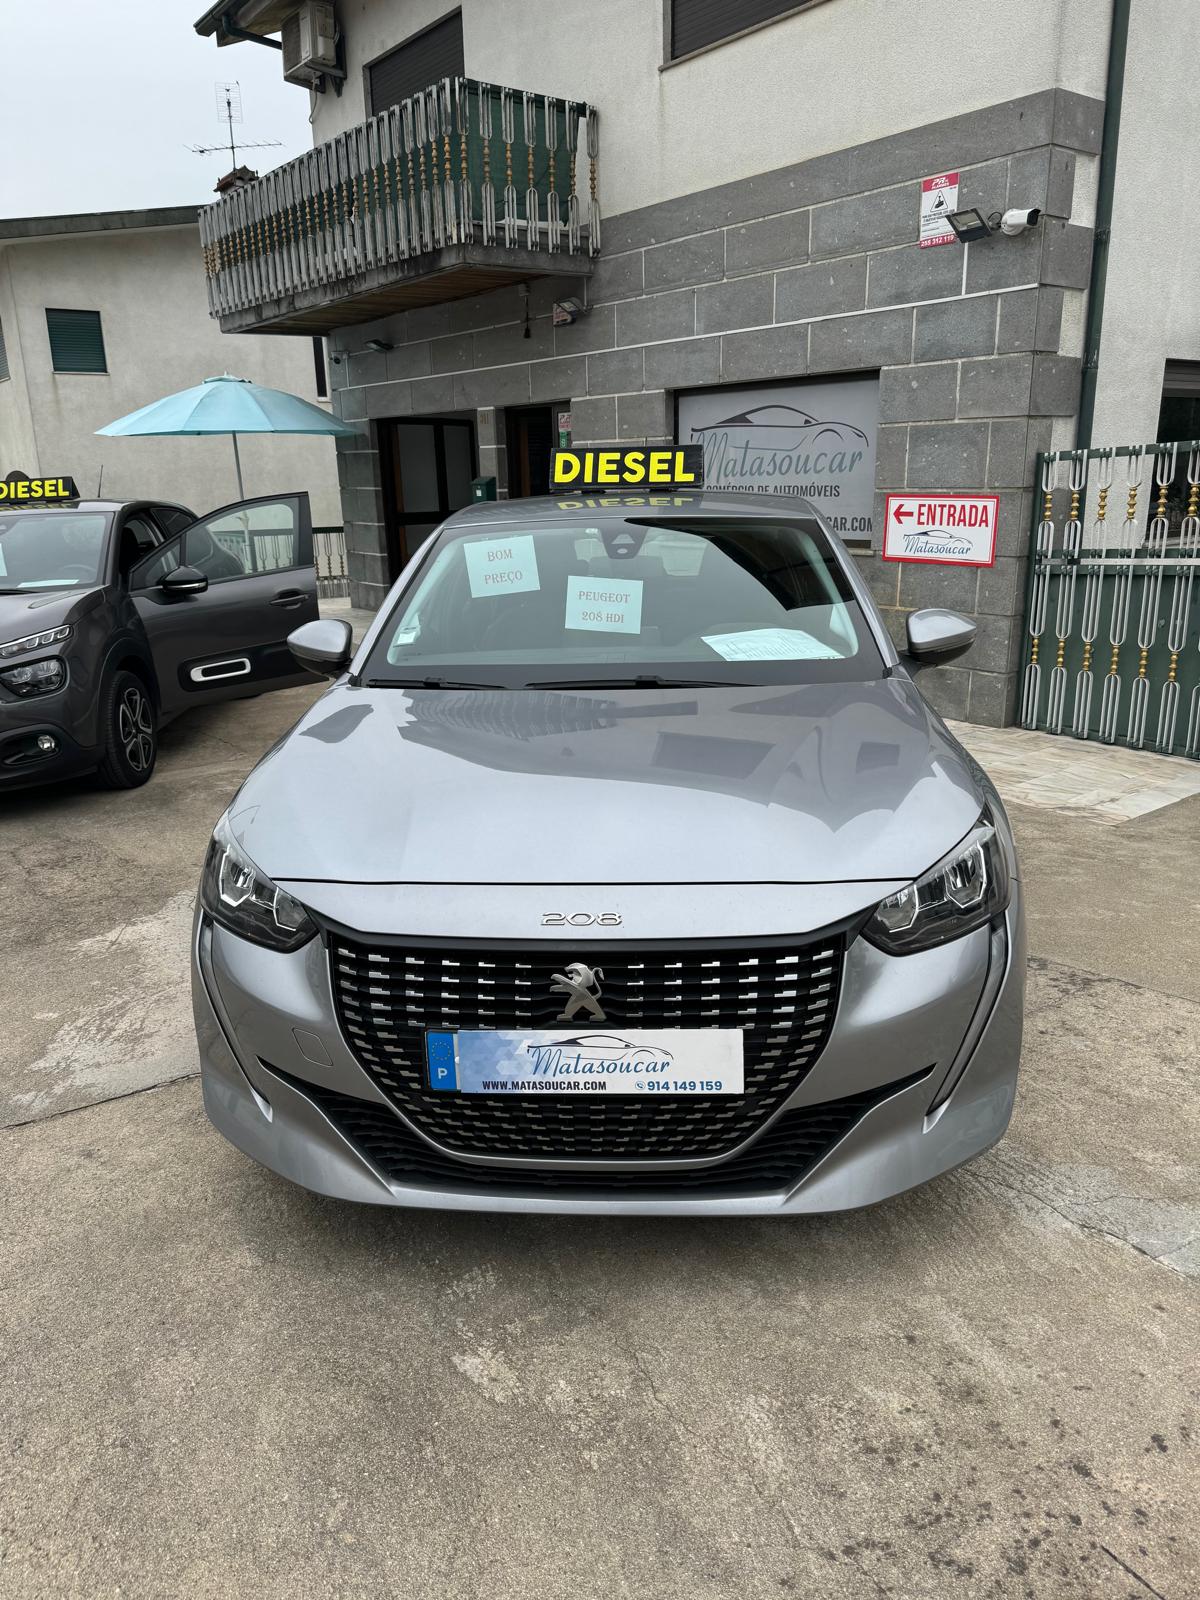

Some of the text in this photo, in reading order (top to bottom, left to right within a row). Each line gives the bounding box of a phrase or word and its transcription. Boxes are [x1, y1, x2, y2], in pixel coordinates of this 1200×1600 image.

[696, 432, 863, 484] Matasoucar
[554, 452, 695, 483] DIESEL
[773, 482, 840, 497] AUTOMÓVEIS
[917, 503, 989, 528] ENTRADA
[903, 536, 971, 555] Matasoucar
[487, 549, 512, 562] BOM
[484, 570, 523, 585] PREÇO
[578, 590, 631, 604] PEUGEOT
[582, 611, 625, 624] 208 HDI
[540, 911, 623, 927] 208
[531, 1047, 670, 1077] Matasoucar
[437, 1067, 448, 1080] P
[482, 1080, 607, 1091] WWW.MATASOUCAR.COM
[647, 1080, 723, 1091] 914 149 159
